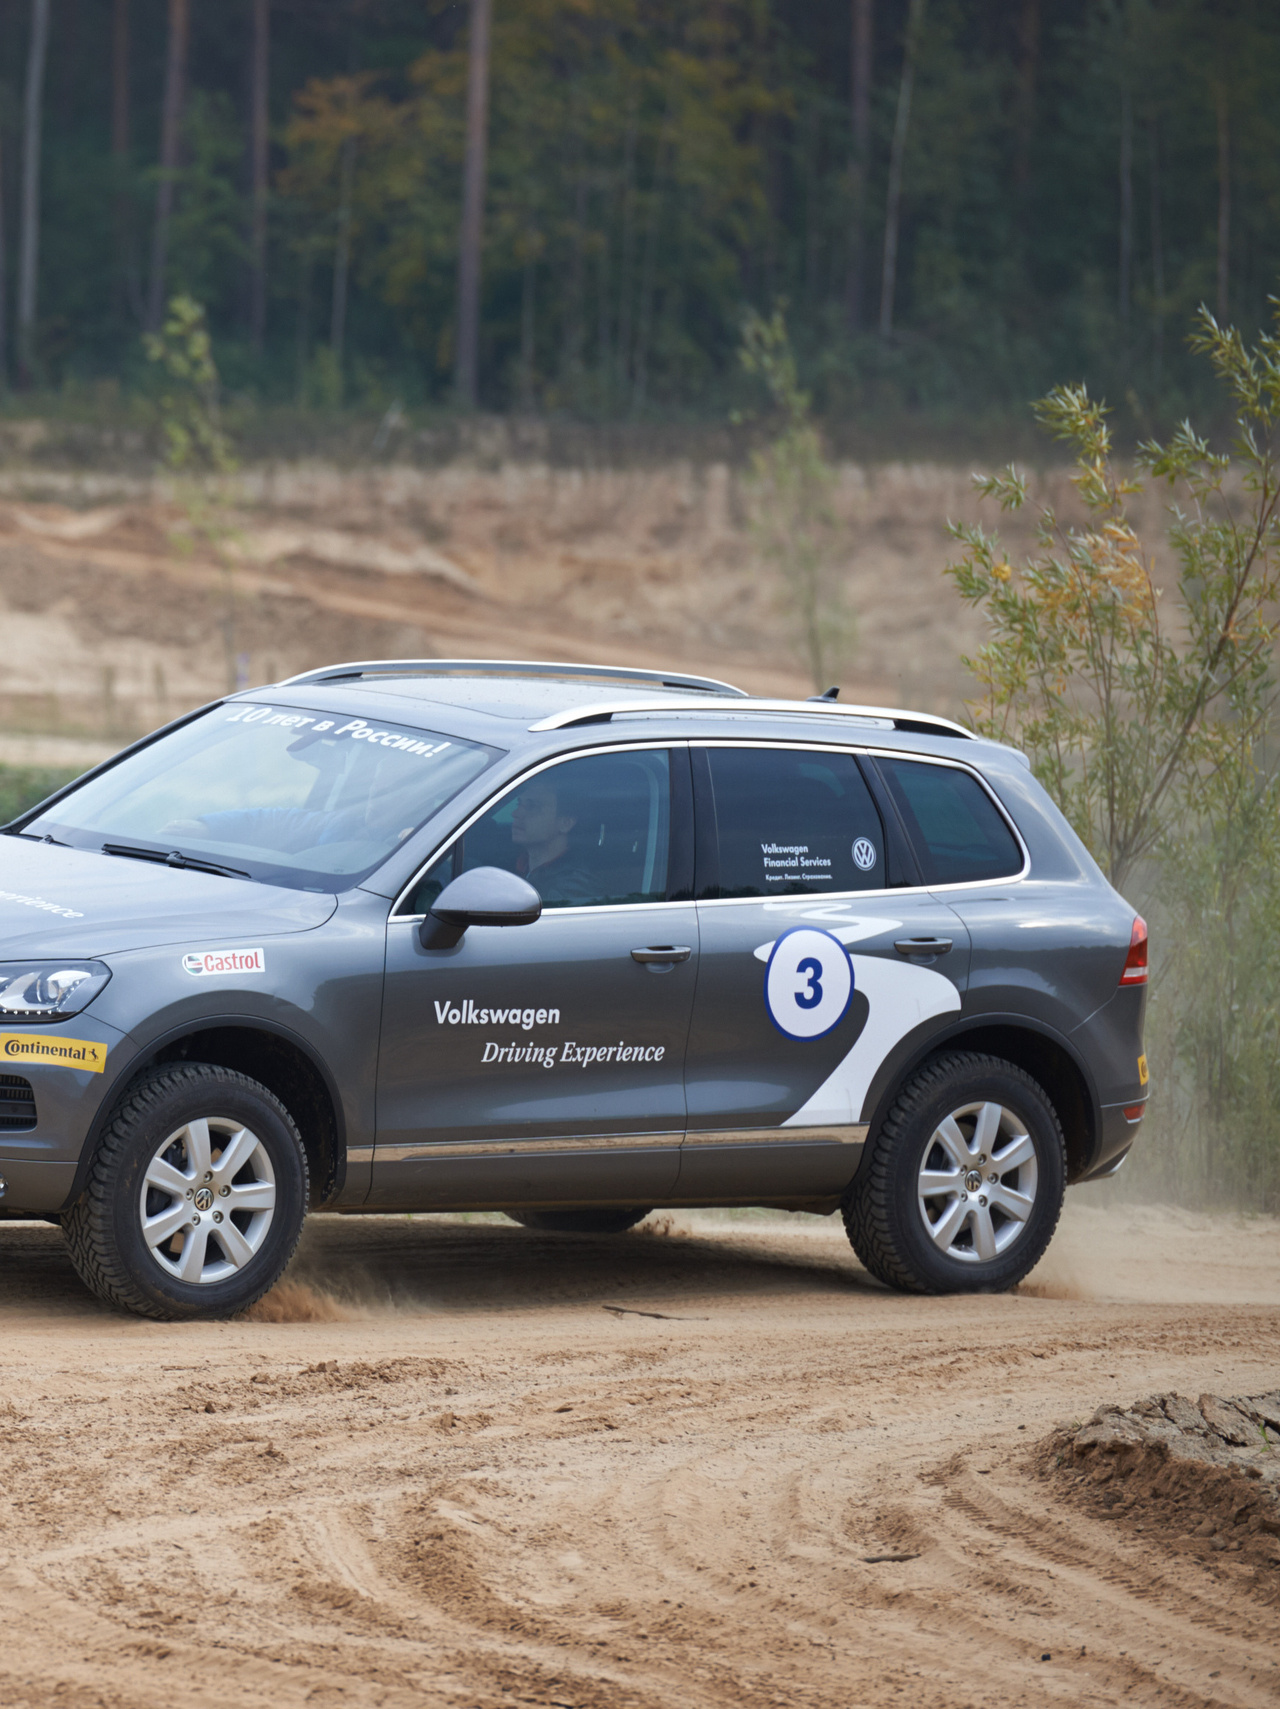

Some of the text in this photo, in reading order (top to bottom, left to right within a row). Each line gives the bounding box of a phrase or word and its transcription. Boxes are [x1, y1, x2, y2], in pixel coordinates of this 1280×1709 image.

[225, 706, 452, 758] 10 лет в России!
[761, 843, 808, 855] Volkswagen
[763, 856, 831, 867] Financial Services
[204, 951, 261, 972] Castrol
[794, 957, 824, 1010] 3
[434, 1000, 560, 1030] Volkswagen
[4, 1039, 86, 1060] Continental
[481, 1041, 665, 1068] Driving Experience
